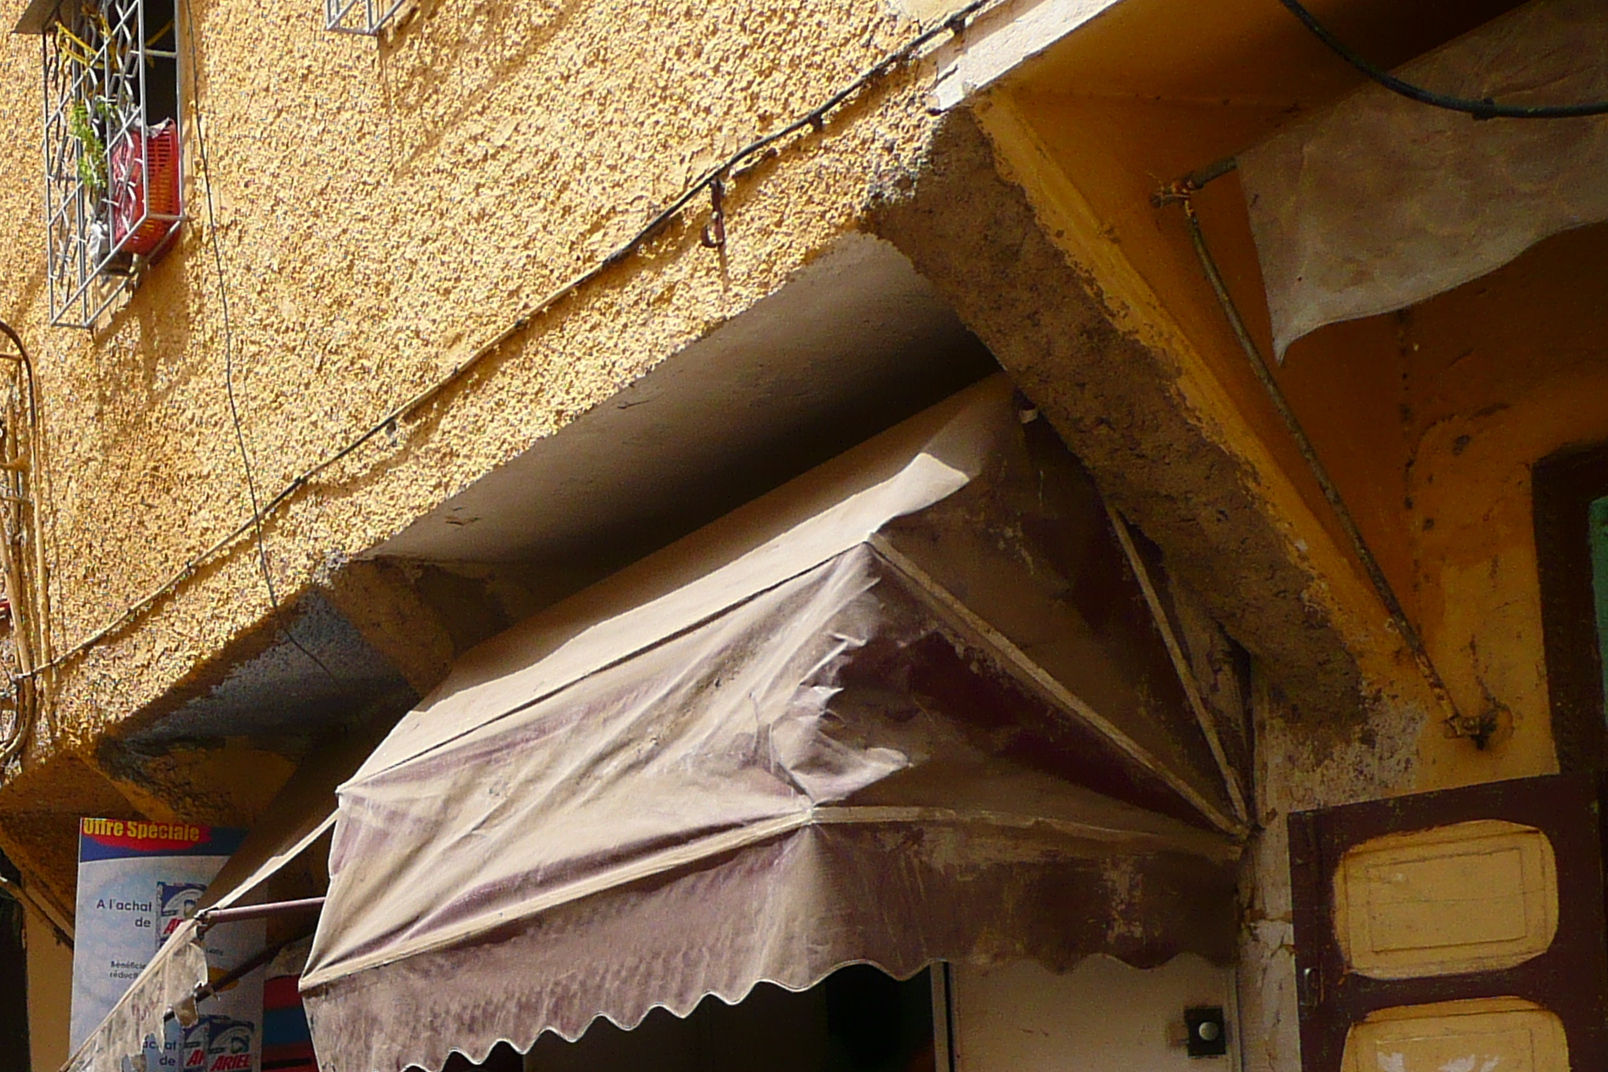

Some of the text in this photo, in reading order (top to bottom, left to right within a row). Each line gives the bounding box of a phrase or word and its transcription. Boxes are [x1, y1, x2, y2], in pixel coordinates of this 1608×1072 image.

[96, 898, 153, 913] A l'achat
[134, 917, 152, 928] de
[159, 1055, 177, 1067] de
[210, 1053, 251, 1072] ARIEL
